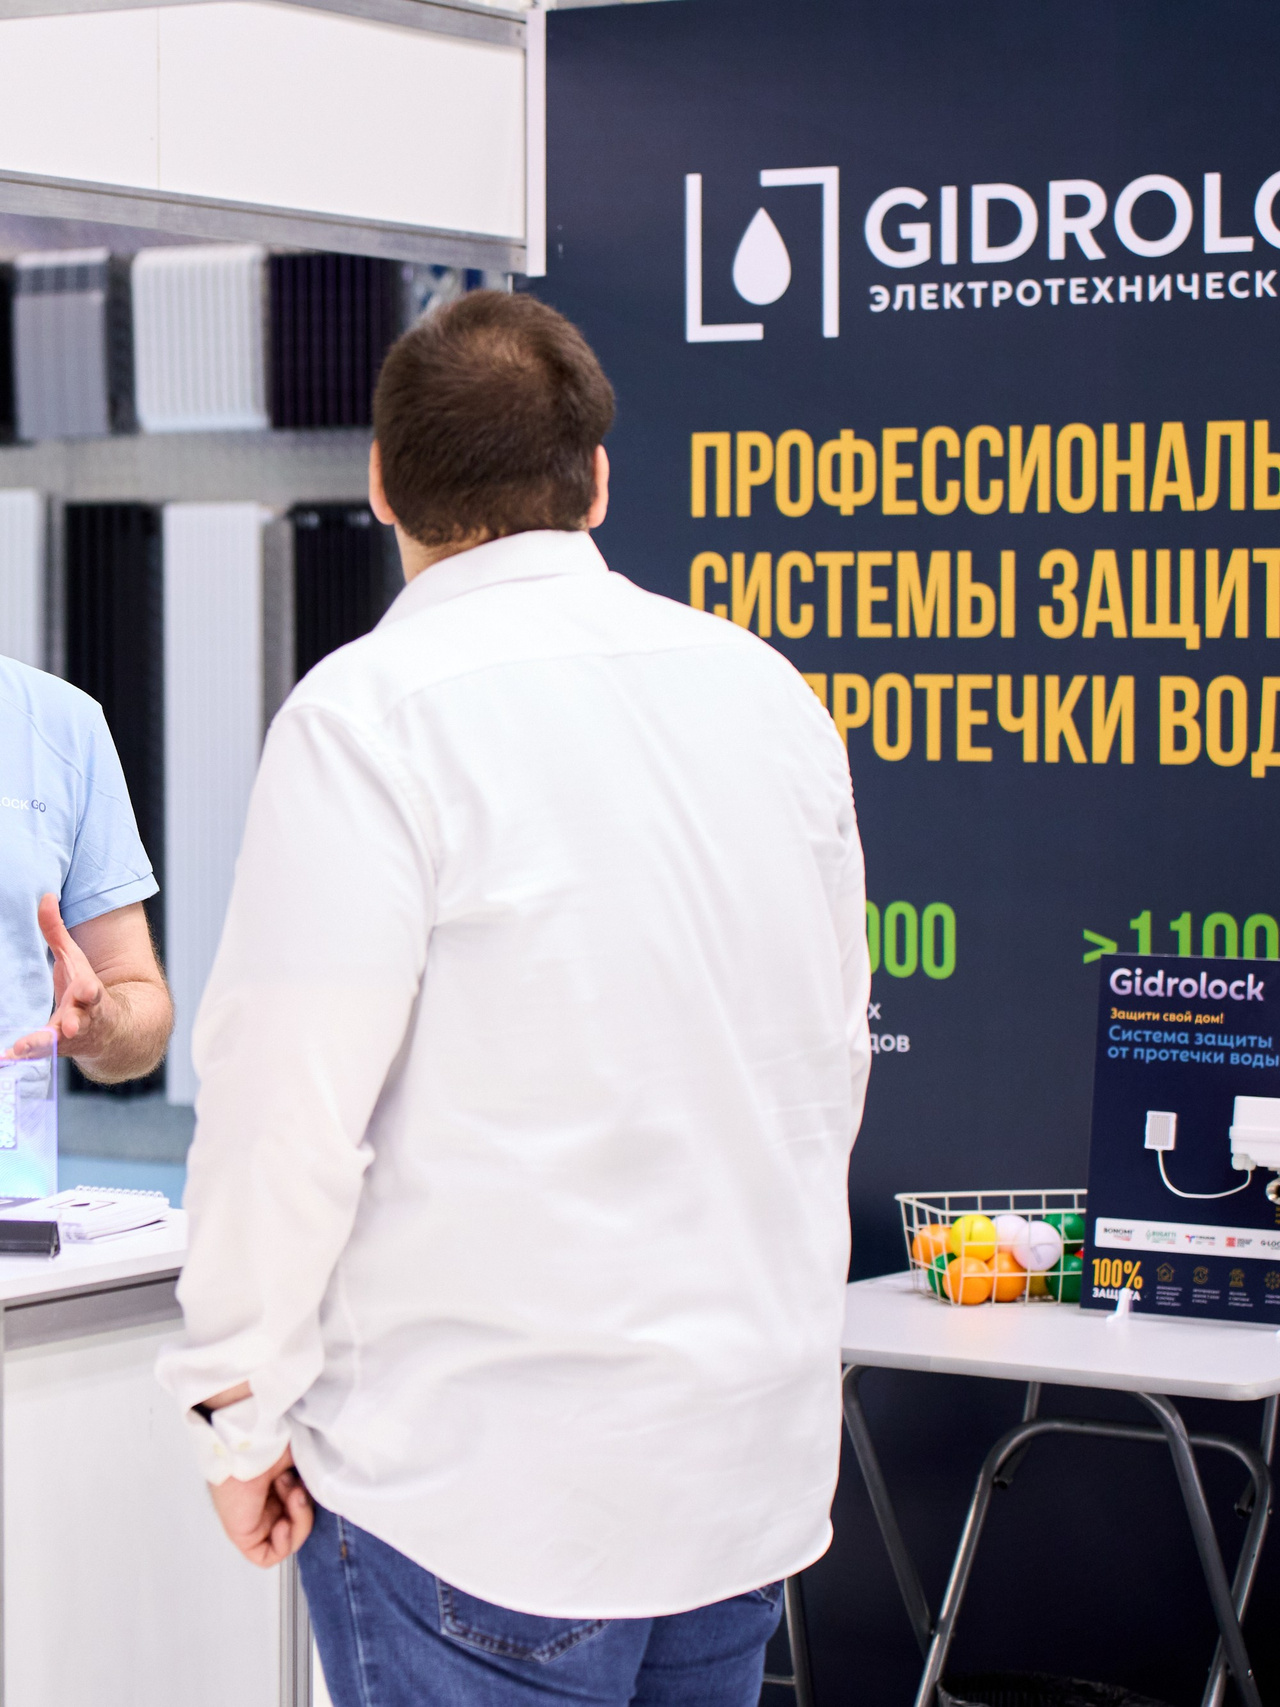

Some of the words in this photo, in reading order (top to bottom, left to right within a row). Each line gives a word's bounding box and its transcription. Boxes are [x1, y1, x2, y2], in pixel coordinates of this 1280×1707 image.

[869, 269, 1279, 312] ЭЛЕКТРОТЕХНИЧЕСК
[690, 419, 1280, 518] ПРОФЕССИОНАЛЬ
[690, 550, 1016, 638] СИСТЕМЫ
[1038, 548, 1280, 650] ЗАЩИТ
[31, 799, 46, 812] GO
[1109, 967, 1265, 1001] Gidrolock
[1110, 1007, 1160, 1022] Защити
[1162, 1010, 1192, 1023] свой
[1194, 1013, 1225, 1025] дом!
[1108, 1024, 1189, 1045] Система
[1194, 1031, 1272, 1049] защиты
[1107, 1046, 1130, 1060] от
[1133, 1047, 1224, 1065] протечки
[1229, 1051, 1280, 1069] воды
[1092, 1257, 1144, 1290] 100%
[1092, 1287, 1141, 1301] ЗАЩА
